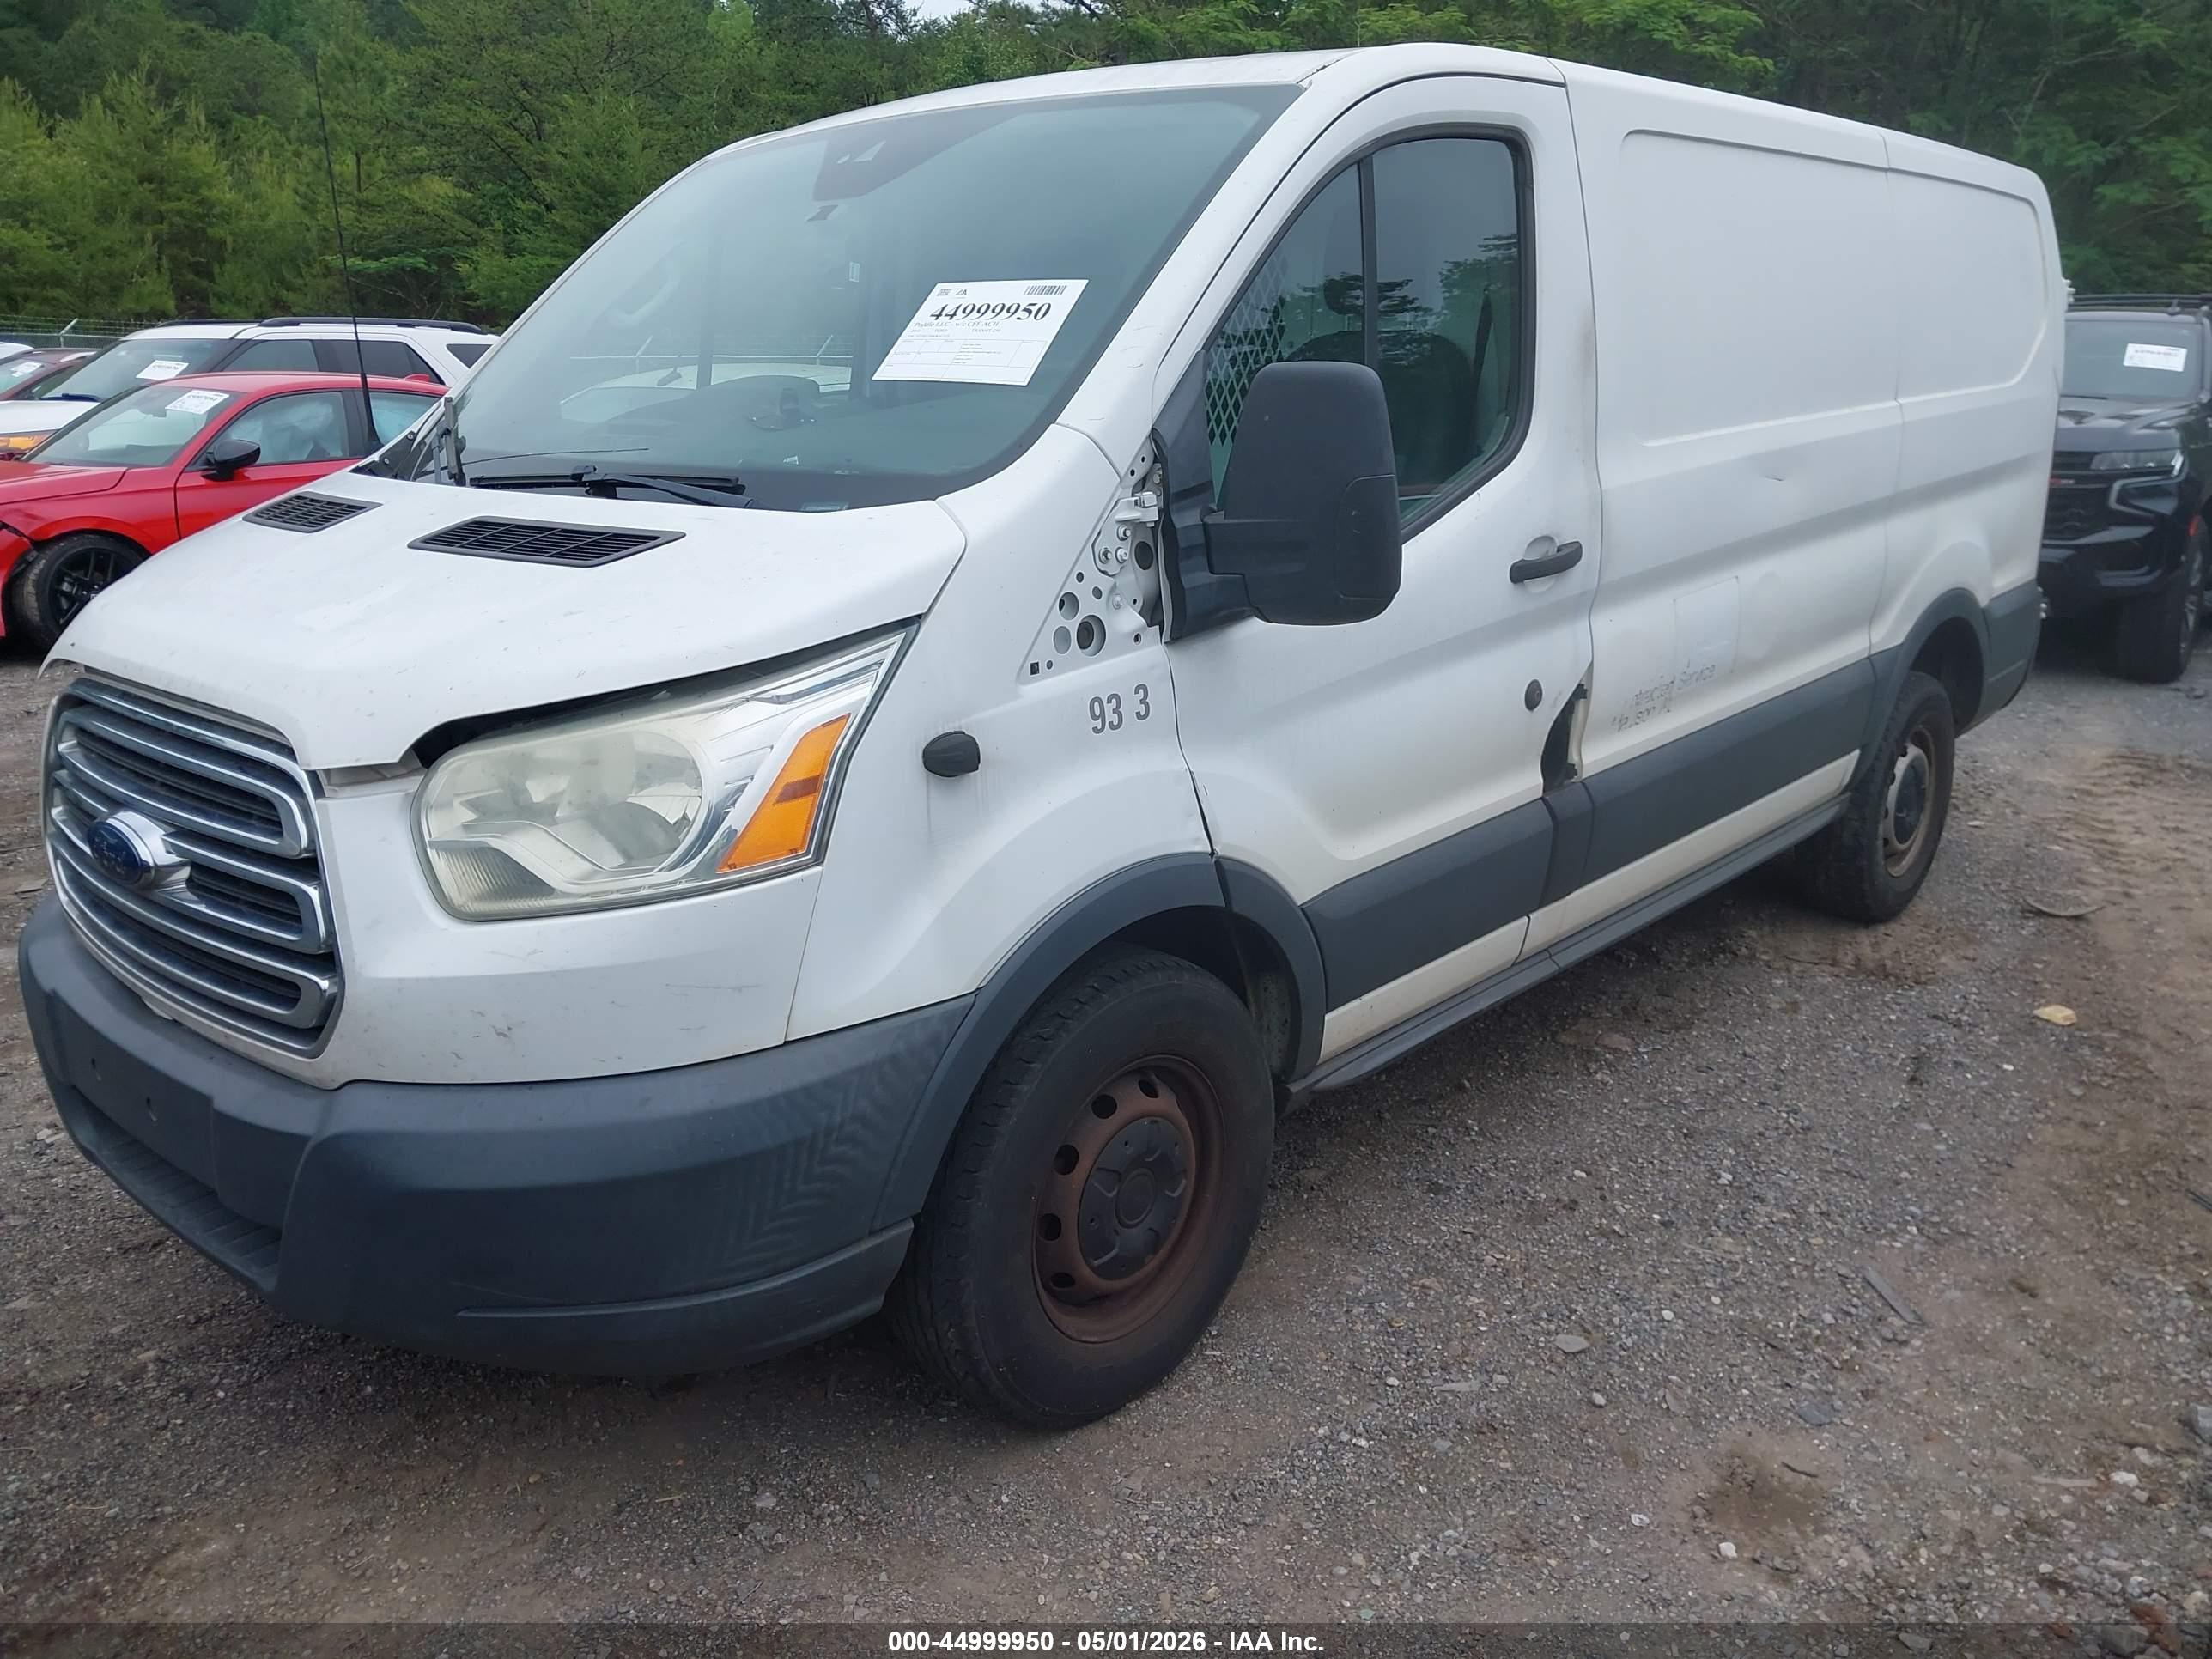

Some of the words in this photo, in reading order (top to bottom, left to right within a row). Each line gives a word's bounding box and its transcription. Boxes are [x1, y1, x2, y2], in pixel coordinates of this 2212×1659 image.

[929, 302, 1052, 321] 44999950
[1089, 693, 1124, 735] 93
[1133, 684, 1151, 721] 3
